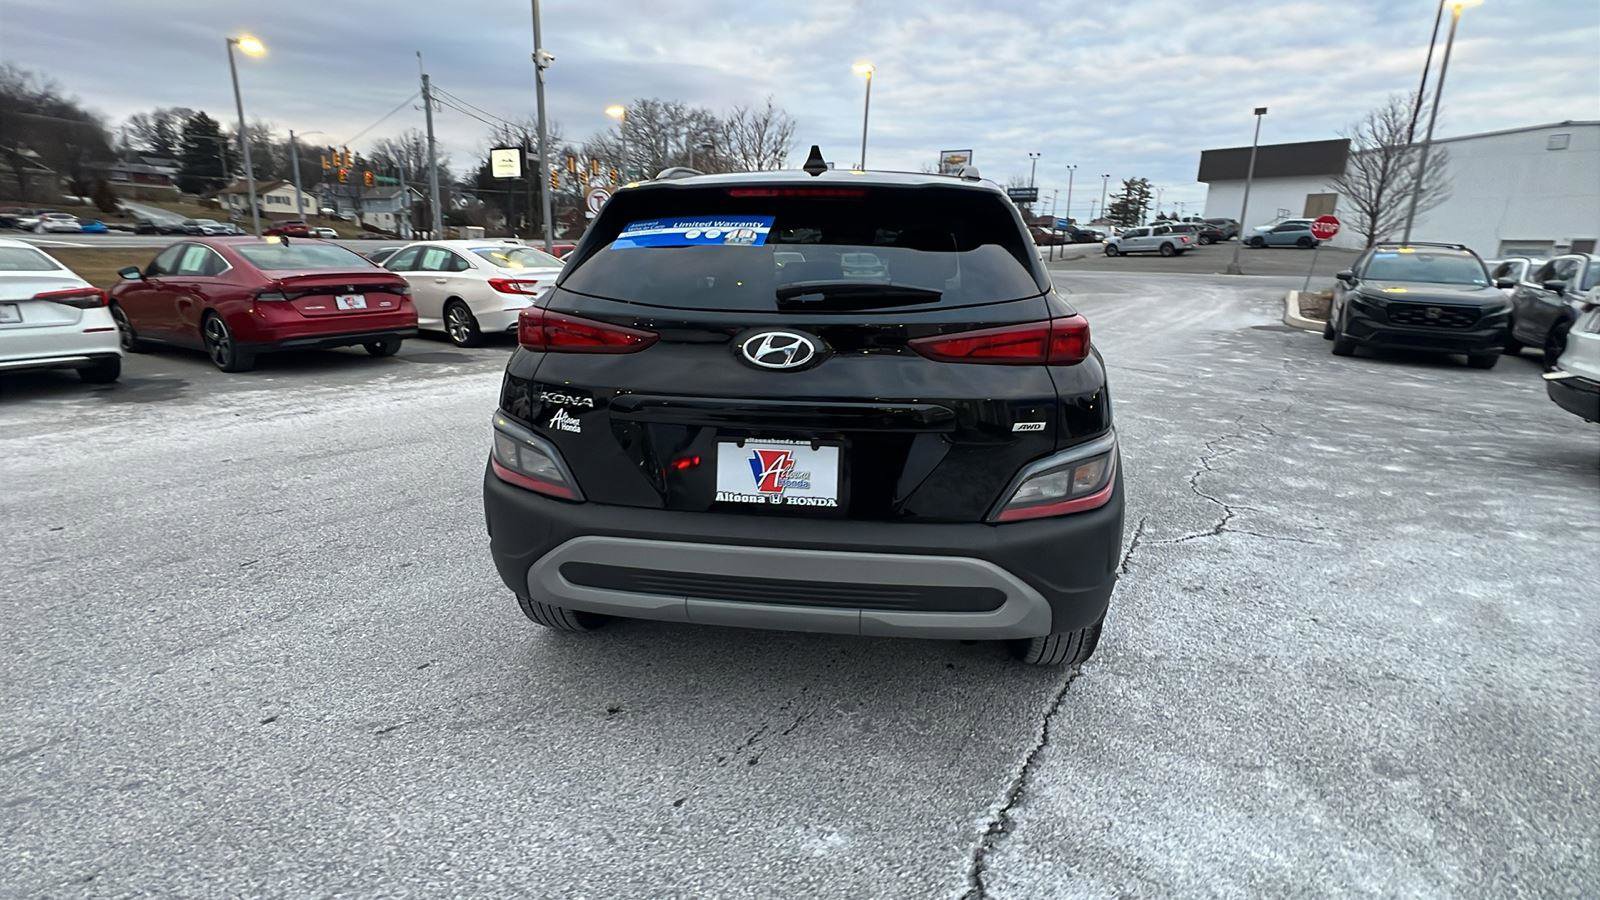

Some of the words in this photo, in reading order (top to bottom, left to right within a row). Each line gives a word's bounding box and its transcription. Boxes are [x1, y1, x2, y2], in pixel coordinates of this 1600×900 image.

[1312, 222, 1339, 233] STOP
[540, 391, 594, 408] KONA
[745, 438, 812, 446] altoonahonda.com
[778, 478, 811, 489] Honda
[715, 491, 766, 504] Altoona
[787, 496, 838, 507] HONDA
